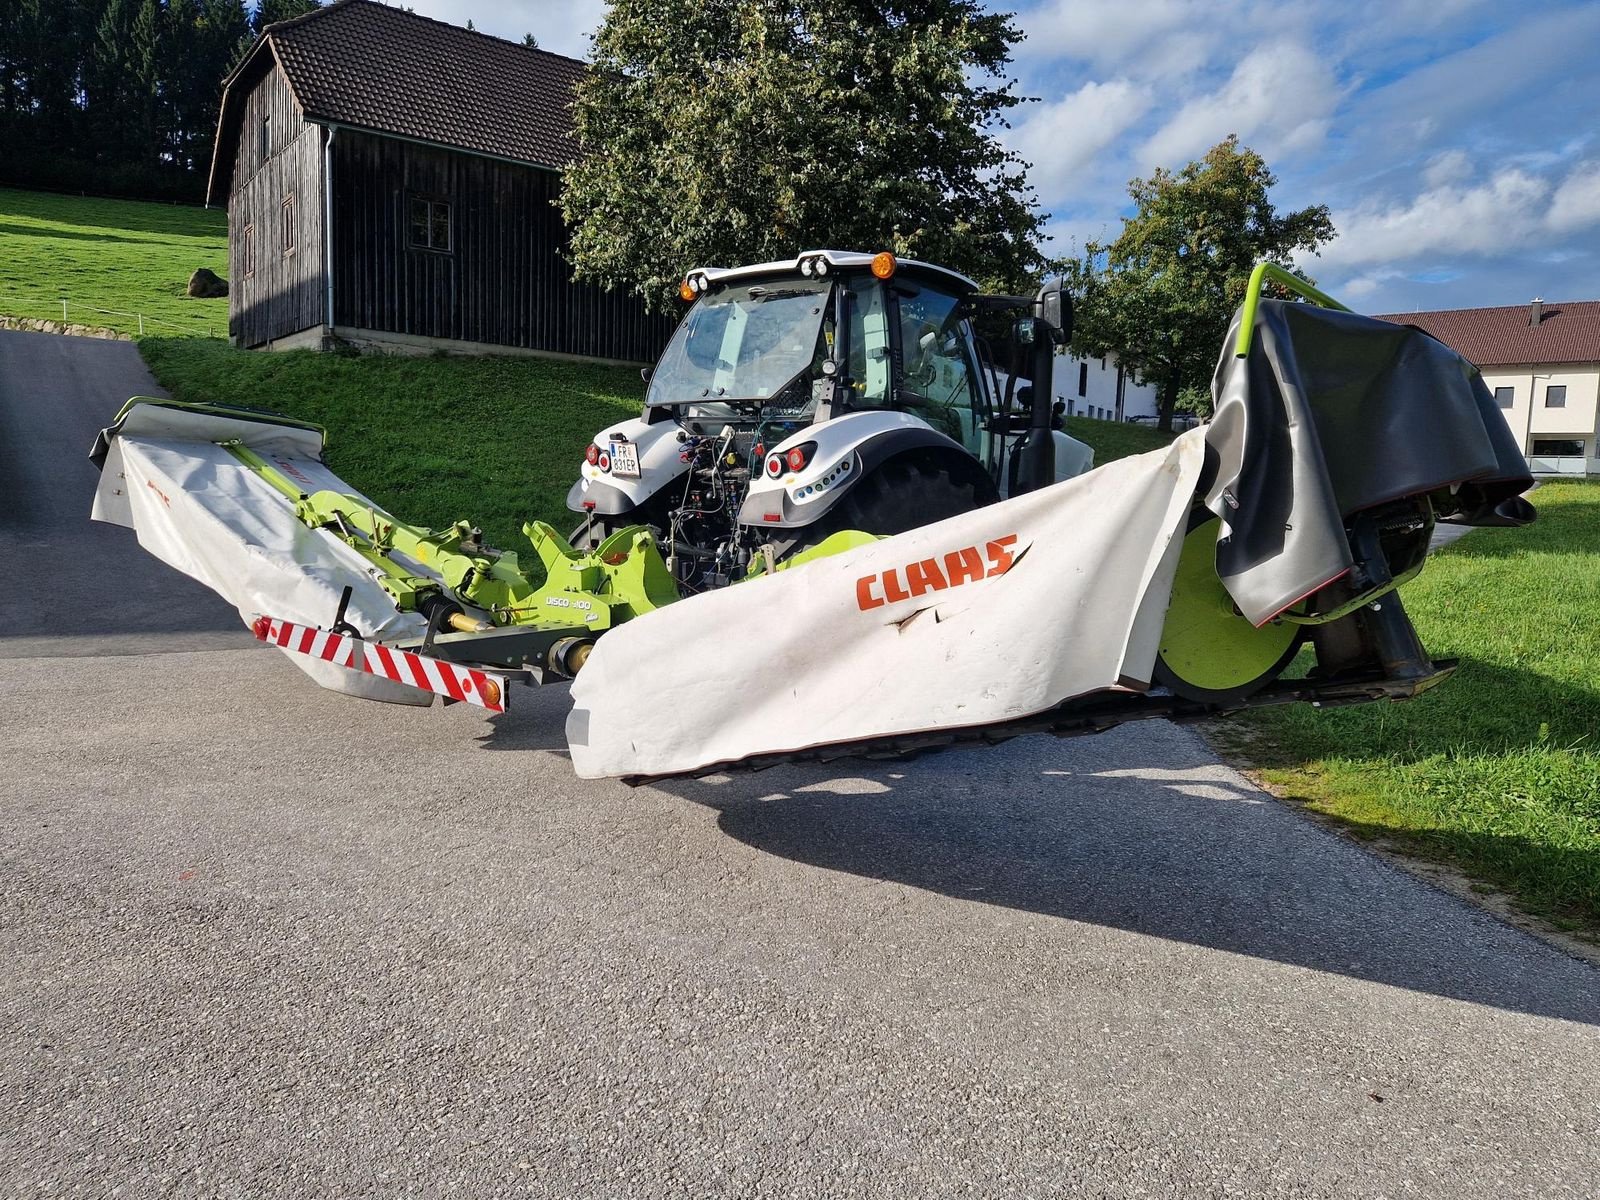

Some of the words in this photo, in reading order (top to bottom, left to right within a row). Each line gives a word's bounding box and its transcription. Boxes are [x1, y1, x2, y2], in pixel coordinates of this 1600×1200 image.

[618, 445, 628, 458] FR
[613, 458, 636, 471] 831ER
[856, 534, 1018, 611] CLAAS
[546, 596, 570, 607] DISCO
